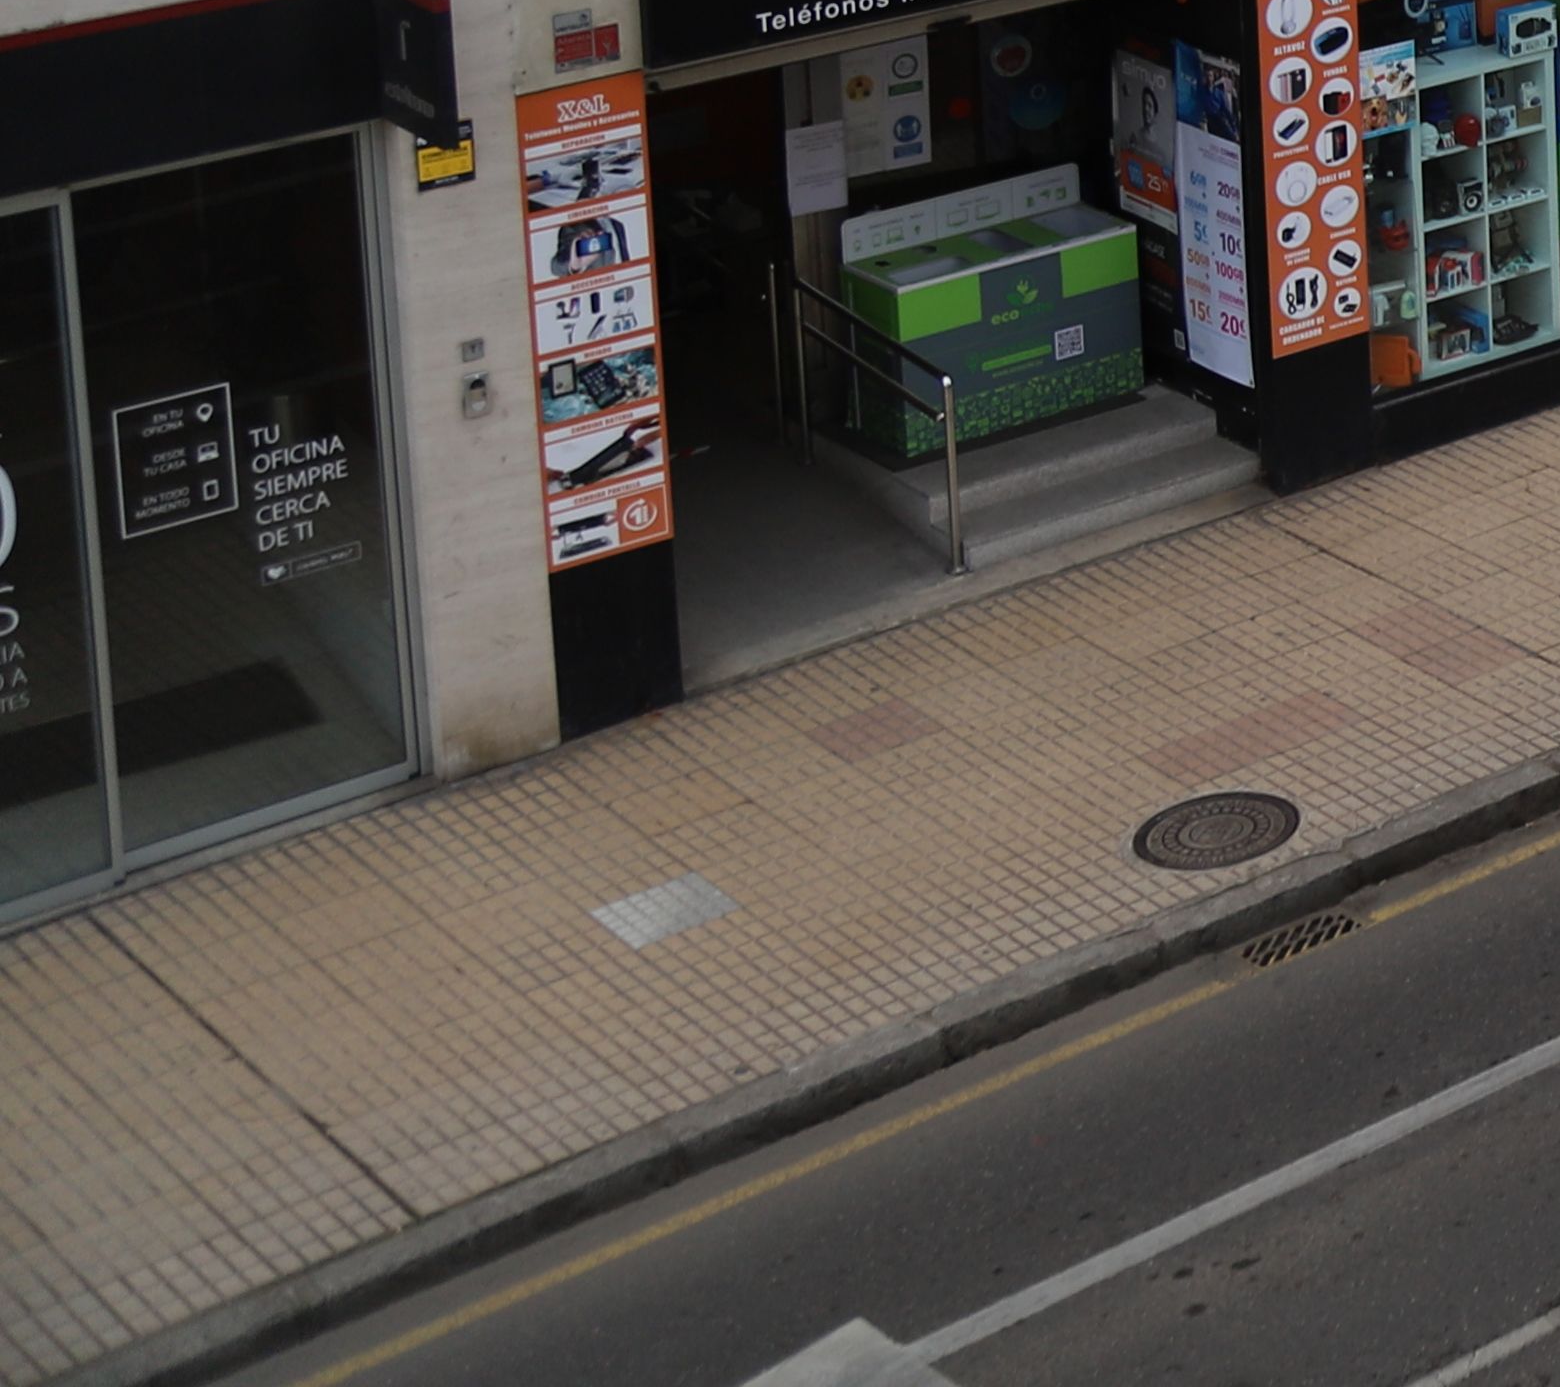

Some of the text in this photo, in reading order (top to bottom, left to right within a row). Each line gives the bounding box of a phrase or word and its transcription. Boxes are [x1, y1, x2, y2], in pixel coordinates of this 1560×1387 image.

[1273, 40, 1307, 56] ALTAVOZ
[1121, 58, 1168, 91] simyo
[557, 94, 610, 124] X&L
[1279, 319, 1315, 336] CARGADOR
[1282, 327, 1323, 346] ORDENADOR
[249, 424, 281, 447] TU
[251, 434, 346, 474] OFICINA
[253, 458, 349, 500] SIEMPRE
[255, 490, 332, 526] CERCA
[258, 520, 314, 552] DE TI
